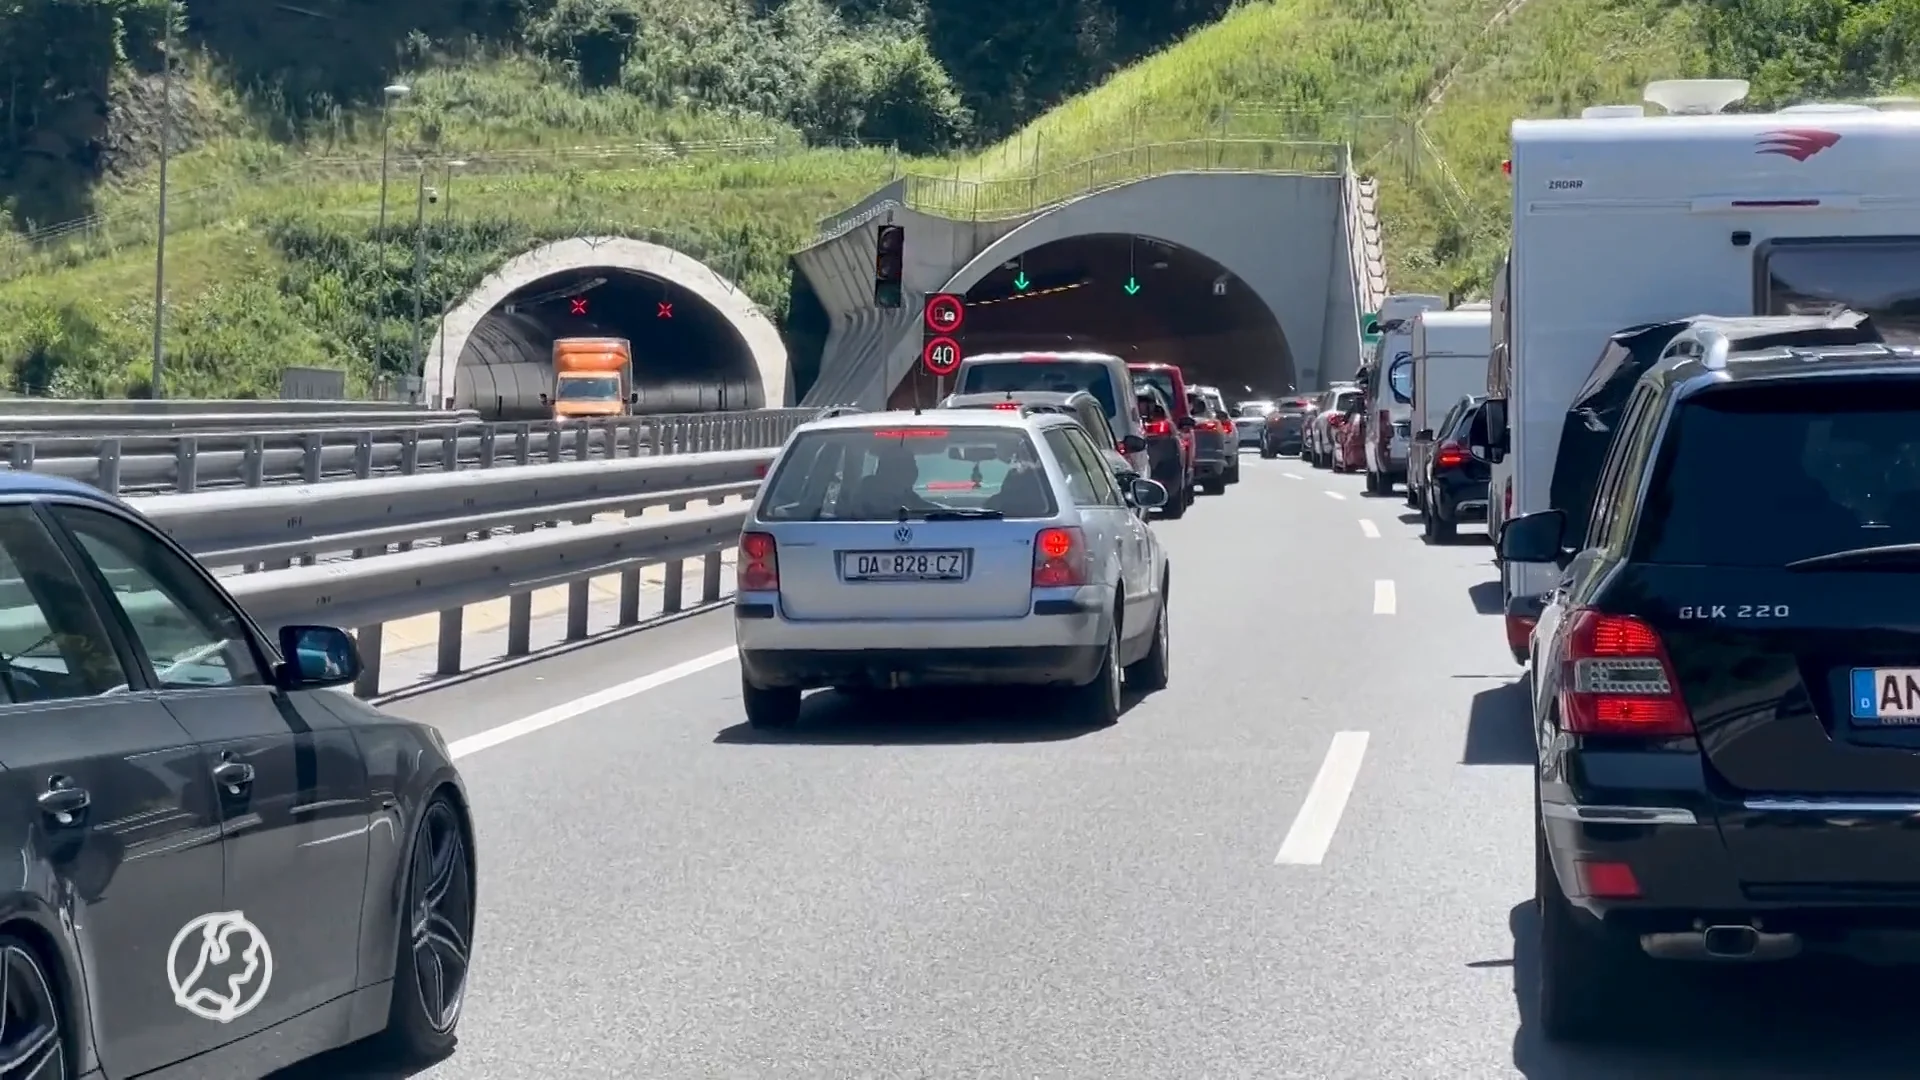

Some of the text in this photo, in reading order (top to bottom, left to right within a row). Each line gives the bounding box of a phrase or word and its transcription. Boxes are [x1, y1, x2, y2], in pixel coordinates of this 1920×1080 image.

[932, 346, 954, 365] 40
[894, 555, 960, 573] 828-CZ
[1679, 605, 1789, 619] GLK 220
[1860, 697, 1871, 709] D
